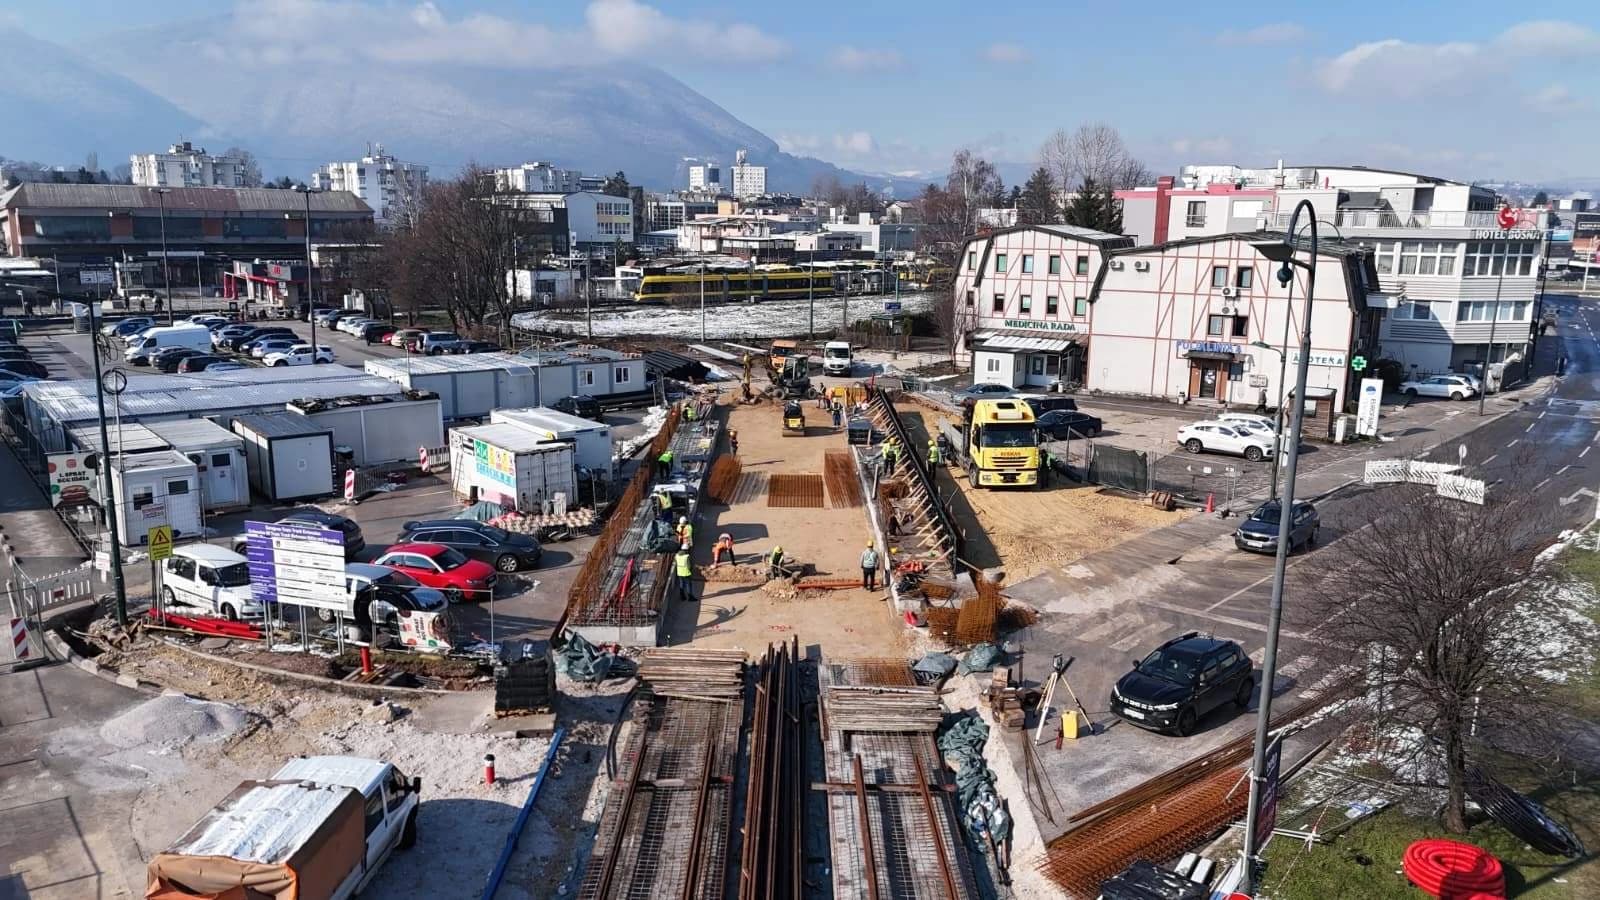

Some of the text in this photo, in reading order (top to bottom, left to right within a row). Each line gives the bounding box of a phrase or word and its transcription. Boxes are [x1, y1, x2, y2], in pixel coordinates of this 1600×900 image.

[1475, 230, 1540, 240] HOTEL BOSNA
[1004, 320, 1076, 331] MEDICINA RADA
[1293, 354, 1343, 365] AOTEKA
